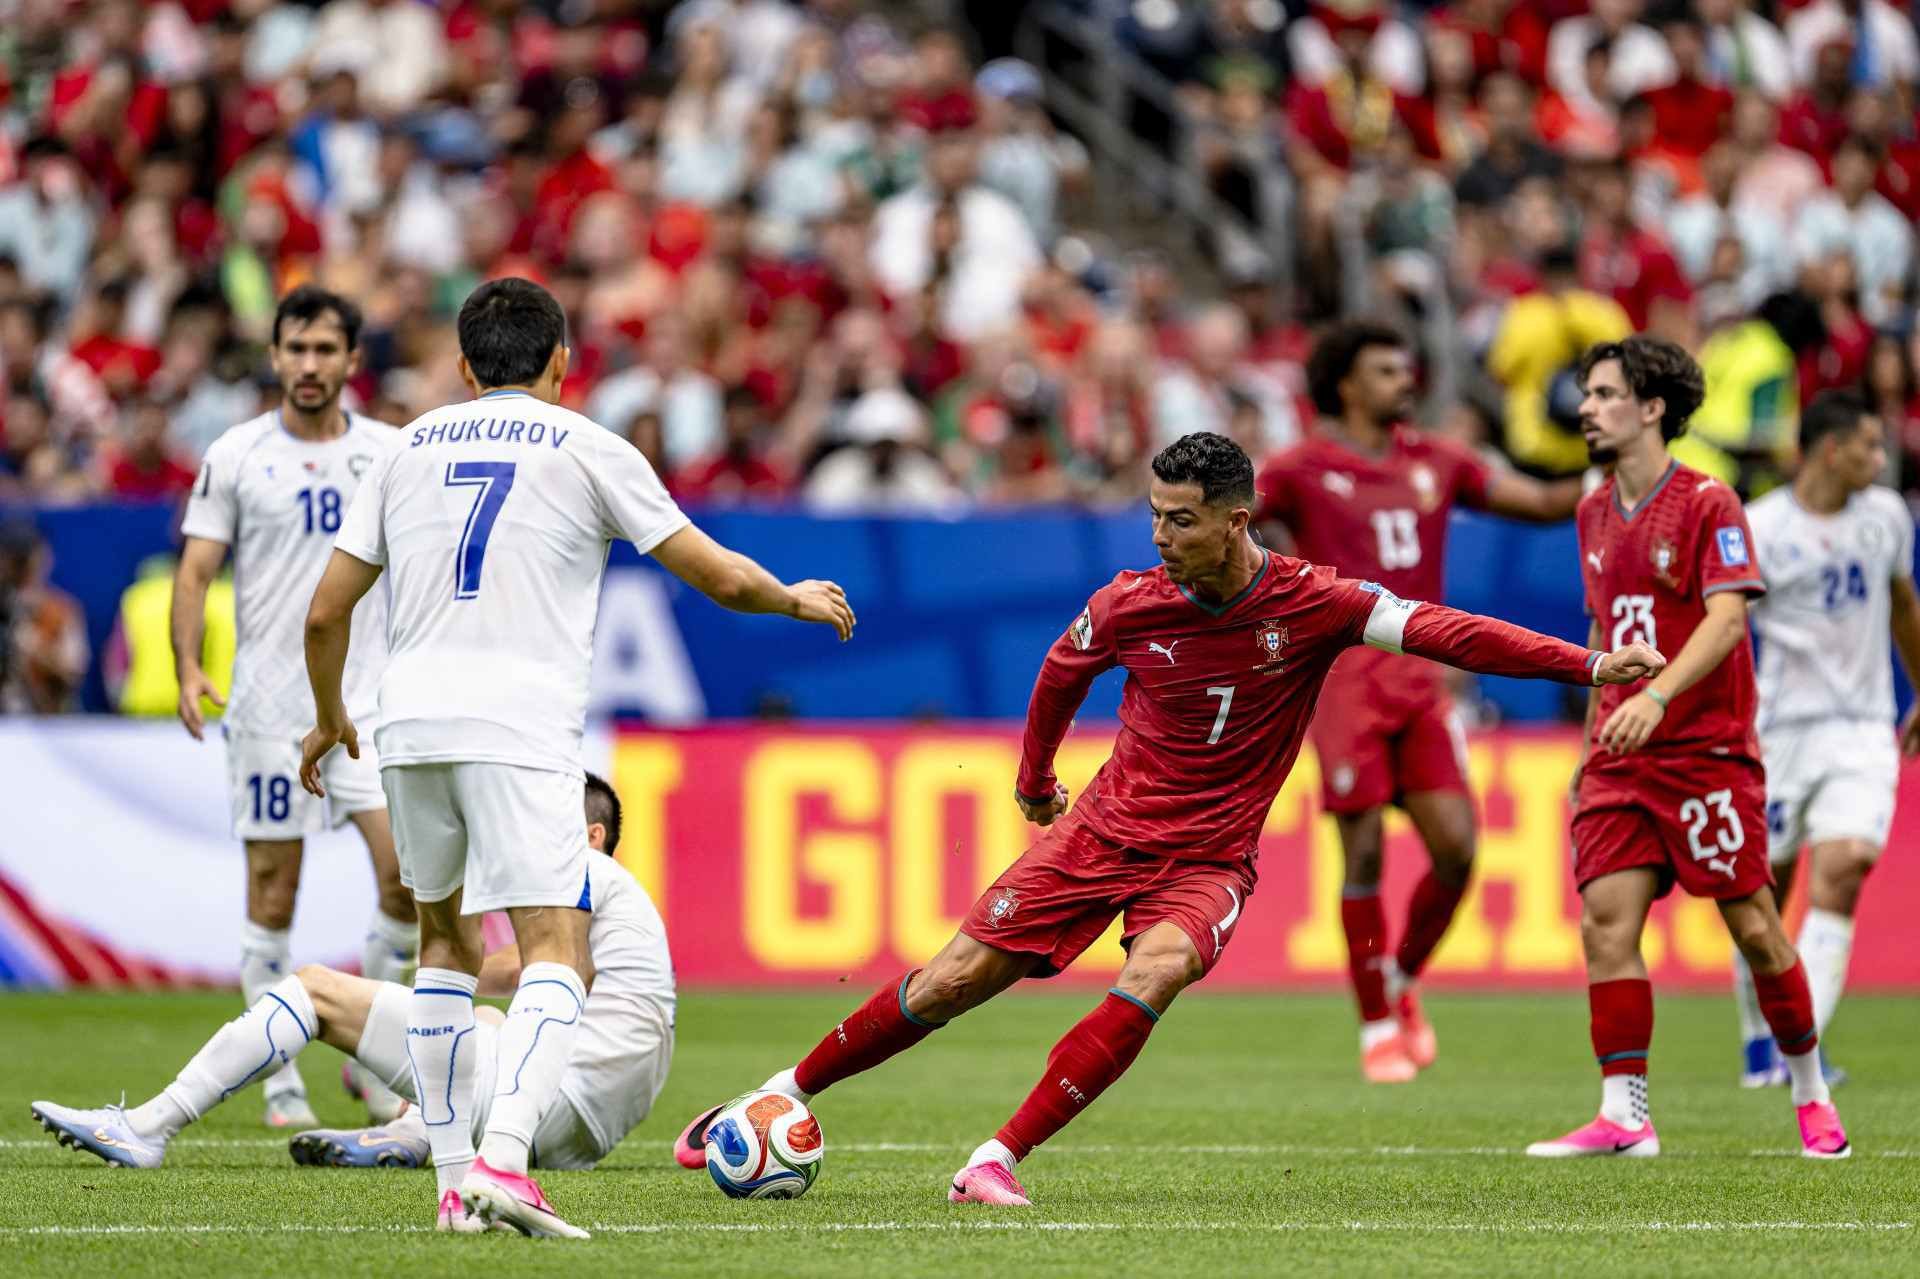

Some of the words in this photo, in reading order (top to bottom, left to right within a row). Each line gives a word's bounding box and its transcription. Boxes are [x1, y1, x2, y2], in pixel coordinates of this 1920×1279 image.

[410, 418, 569, 449] SHUKUROV
[296, 486, 343, 535] 18
[444, 460, 517, 601] 7
[1369, 508, 1422, 571] 13
[1611, 595, 1657, 653] 23
[1206, 685, 1236, 745] 7
[247, 774, 291, 822] 18
[1680, 788, 1744, 861] 23
[742, 738, 1131, 970] GO
